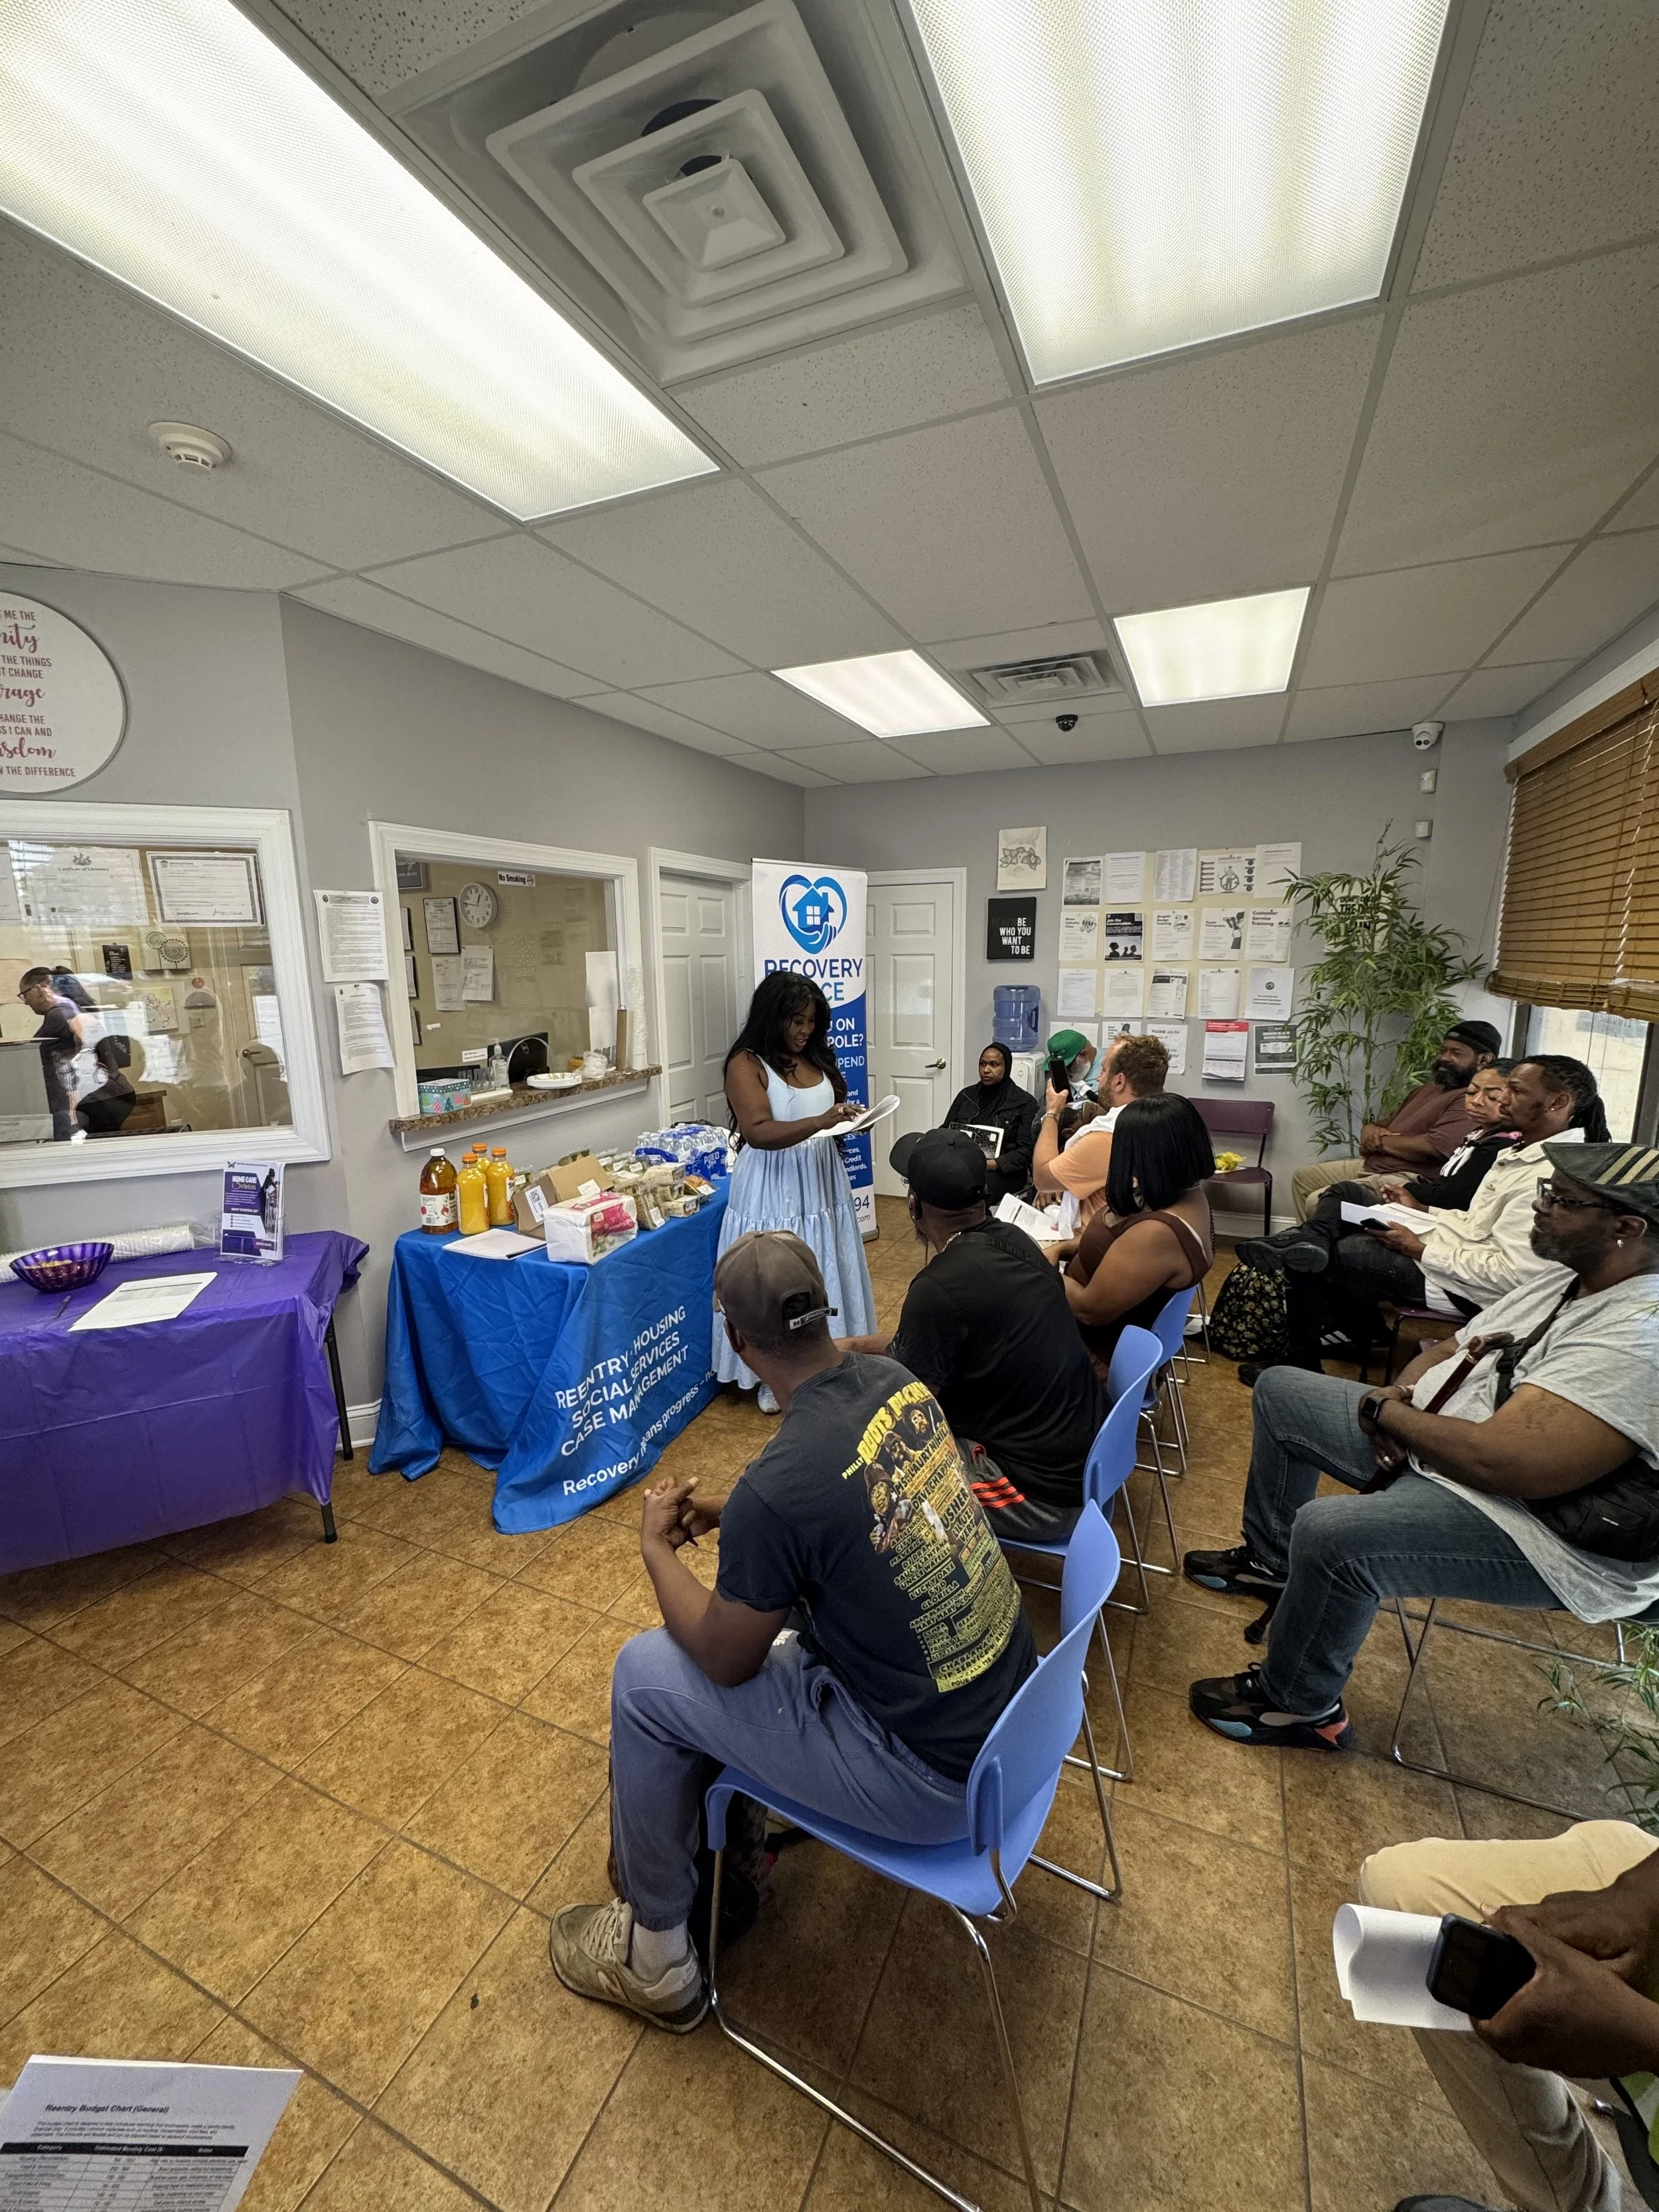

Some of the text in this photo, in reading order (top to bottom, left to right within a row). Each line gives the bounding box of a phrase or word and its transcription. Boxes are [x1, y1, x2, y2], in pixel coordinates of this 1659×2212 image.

[4, 610, 36, 621] ME THE
[1, 655, 52, 667] THE THINGS
[9, 668, 44, 679] CHANGE
[0, 684, 46, 707] rage
[29, 715, 46, 724] THE
[9, 726, 52, 737] I CAN AND
[5, 766, 76, 777] THE DIFFERENCE
[506, 874, 526, 885] Smoking
[999, 926, 1031, 936] WHO YOU
[1017, 917, 1027, 926] BE
[1001, 936, 1022, 945] WANT
[1011, 945, 1031, 954] TO BE
[764, 958, 863, 979] RECOVERY
[836, 1017, 855, 1031] ON
[845, 1155, 862, 1163] Credit
[845, 1163, 868, 1173] ndlords,
[855, 1194, 870, 1211] 94
[555, 1305, 686, 1409] REENTRY HOUSING
[571, 1331, 680, 1429] SOCIAL SERVICES
[561, 1345, 689, 1456] CASE MANAGEMENT
[563, 1451, 640, 1496] Recovery
[662, 1383, 699, 1428] progress
[841, 1455, 865, 1480] PHILLY
[857, 1407, 895, 1466] ROOTS
[907, 1441, 938, 1477] LAURYN
[912, 1483, 930, 1511] DAVE
[940, 1487, 970, 1530] USHER
[960, 1506, 975, 1526] UZI
[891, 1513, 925, 1548] ARI LENNOX
[896, 1522, 927, 1553] CITY GIRLS
[959, 1519, 976, 1544] VERT
[890, 1537, 924, 1566] MAVERICK
[894, 1540, 949, 1585] SAUCY SANTANA
[902, 1539, 937, 1570] DJ DRAMA
[899, 1546, 951, 1589] UNCLE WAFFLES
[909, 1561, 956, 1600] LUCKY DAYE
[928, 1580, 946, 1597] SYD
[921, 1580, 960, 1610] GLORILLA
[910, 1588, 965, 1629] ADAM BLACKSTONE
[915, 1617, 936, 1633] MARY
[936, 1605, 956, 1621] MARY
[931, 1628, 982, 1661] LITTLE BROTHER
[955, 1648, 989, 1674] SERVICE
[965, 1664, 982, 1677] CALL
[951, 1677, 970, 1687] POUR
[45, 2104, 170, 2114] Reentry Budget Chart (General)
